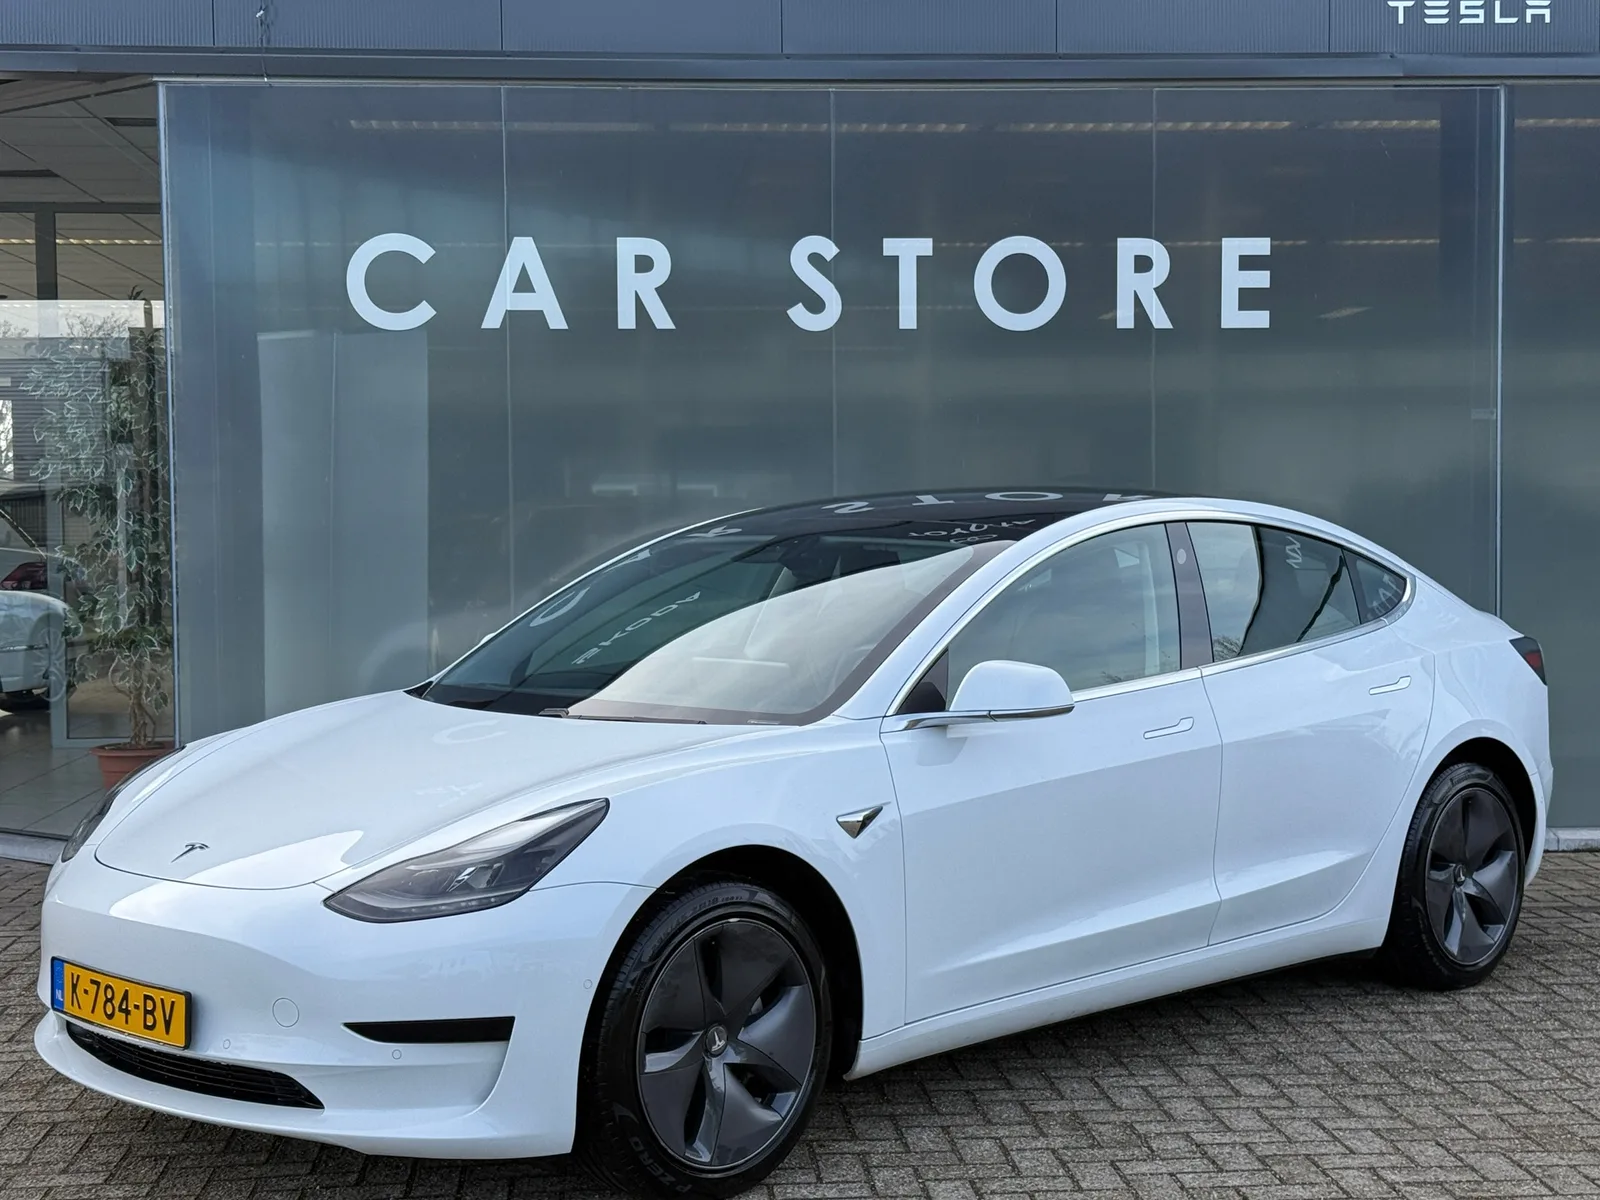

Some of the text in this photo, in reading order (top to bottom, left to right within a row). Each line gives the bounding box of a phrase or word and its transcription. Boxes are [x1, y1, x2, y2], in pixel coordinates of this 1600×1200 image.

[1387, 0, 1551, 24] TESLA
[346, 232, 1272, 331] CAR STORE
[55, 972, 176, 1035] NL K-784-BV
